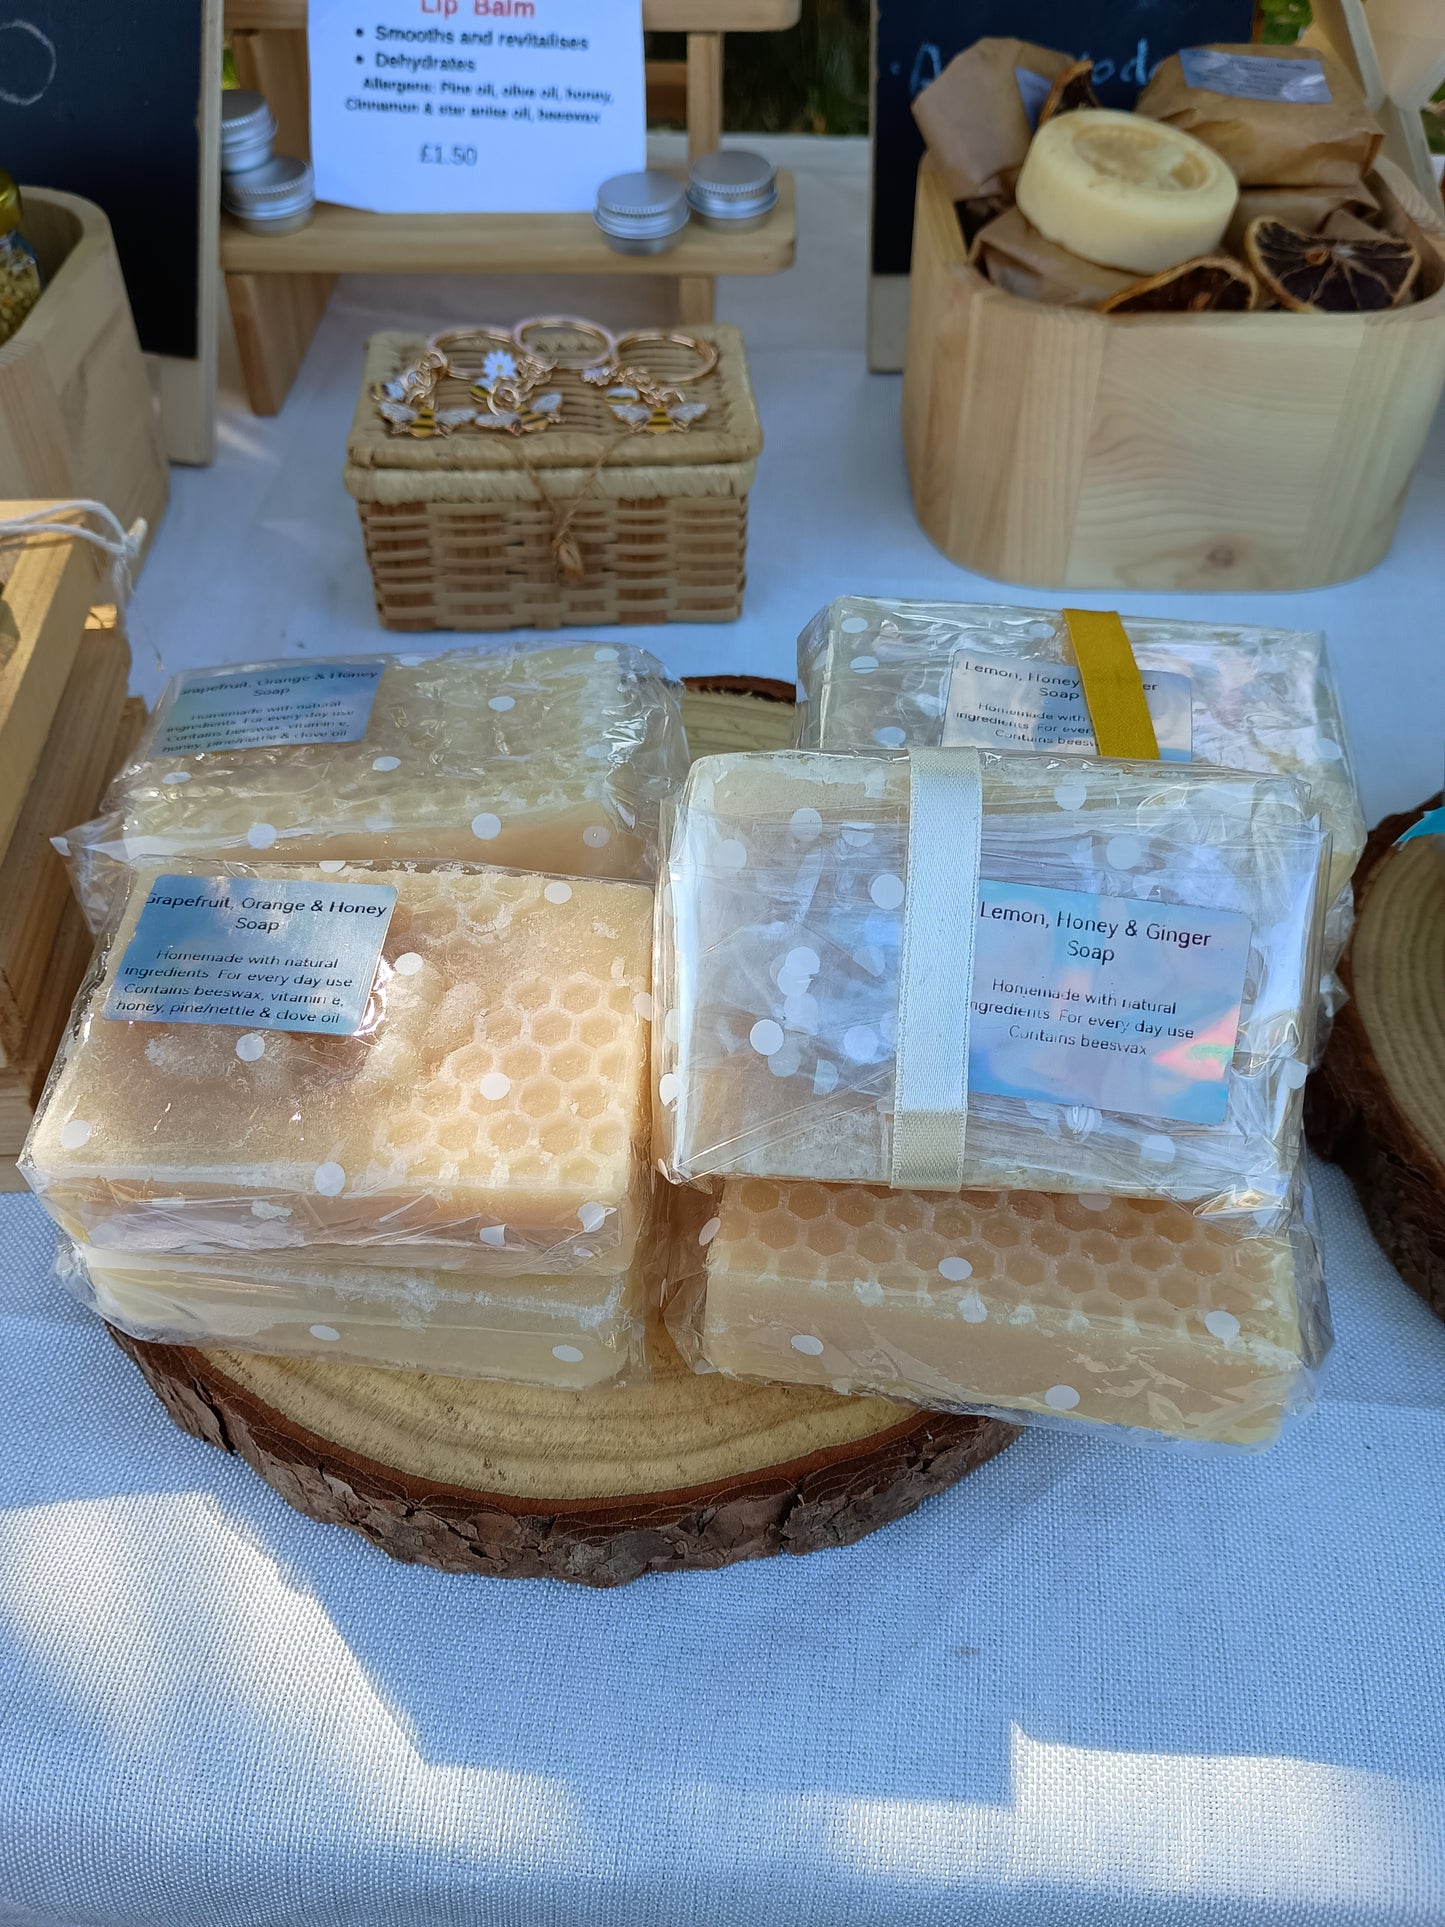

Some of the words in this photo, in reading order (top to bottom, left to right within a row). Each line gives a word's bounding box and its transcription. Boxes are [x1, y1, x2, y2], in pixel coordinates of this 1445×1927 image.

[474, 0, 535, 18] Balm
[376, 25, 455, 46] Smooths
[460, 31, 493, 47] and
[498, 31, 590, 51] revitalises
[376, 52, 477, 74] Dehydrates
[420, 143, 478, 166] £1.50
[257, 676, 312, 686] Orange
[330, 671, 379, 681] Honey
[965, 661, 1022, 681] Lemon,
[1028, 672, 1080, 689] Honey
[252, 687, 290, 697] Soap
[1039, 687, 1080, 702] Soap
[192, 708, 263, 720] Homemade
[267, 705, 294, 713] with
[297, 701, 342, 710] natural
[267, 714, 303, 722] every
[305, 710, 329, 719] day
[978, 702, 1054, 720] Homemade
[1057, 714, 1086, 722] with
[166, 731, 222, 742] Contains
[288, 721, 335, 729] vitamin
[331, 730, 348, 738] oil
[995, 729, 1054, 744] Contains
[1037, 724, 1057, 733] For
[242, 897, 306, 914] Orange
[310, 900, 323, 912] &
[329, 901, 387, 918] Honey
[235, 917, 280, 934] Soap
[980, 901, 1050, 929] Lemon,
[1057, 910, 1119, 939] Honey
[1125, 920, 1138, 937] &
[1146, 923, 1212, 949] Ginger
[156, 949, 244, 964] Homemade
[248, 955, 280, 966] with
[284, 957, 339, 969] natural
[1067, 940, 1115, 966] Soap
[218, 969, 242, 981] For
[247, 973, 290, 986] every
[294, 974, 322, 989] day
[124, 983, 192, 996] Contains
[194, 985, 265, 1001] beeswax,
[271, 992, 327, 1004] vitamin
[331, 998, 344, 1008] e,
[992, 977, 1080, 1002] Homemade
[1085, 993, 1117, 1007] with
[1121, 999, 1177, 1015] natural
[116, 1000, 165, 1015] honey,
[169, 1003, 255, 1018] pine/nettle
[259, 1006, 271, 1019] &
[276, 1009, 317, 1022] clove
[321, 1013, 341, 1024] oil
[970, 1001, 1050, 1020] ngredients
[1059, 1009, 1083, 1025] For
[1088, 1016, 1130, 1035] every
[1135, 1020, 1163, 1038] day
[1009, 1025, 1076, 1046] Contains
[1081, 1035, 1147, 1056] beeswax
